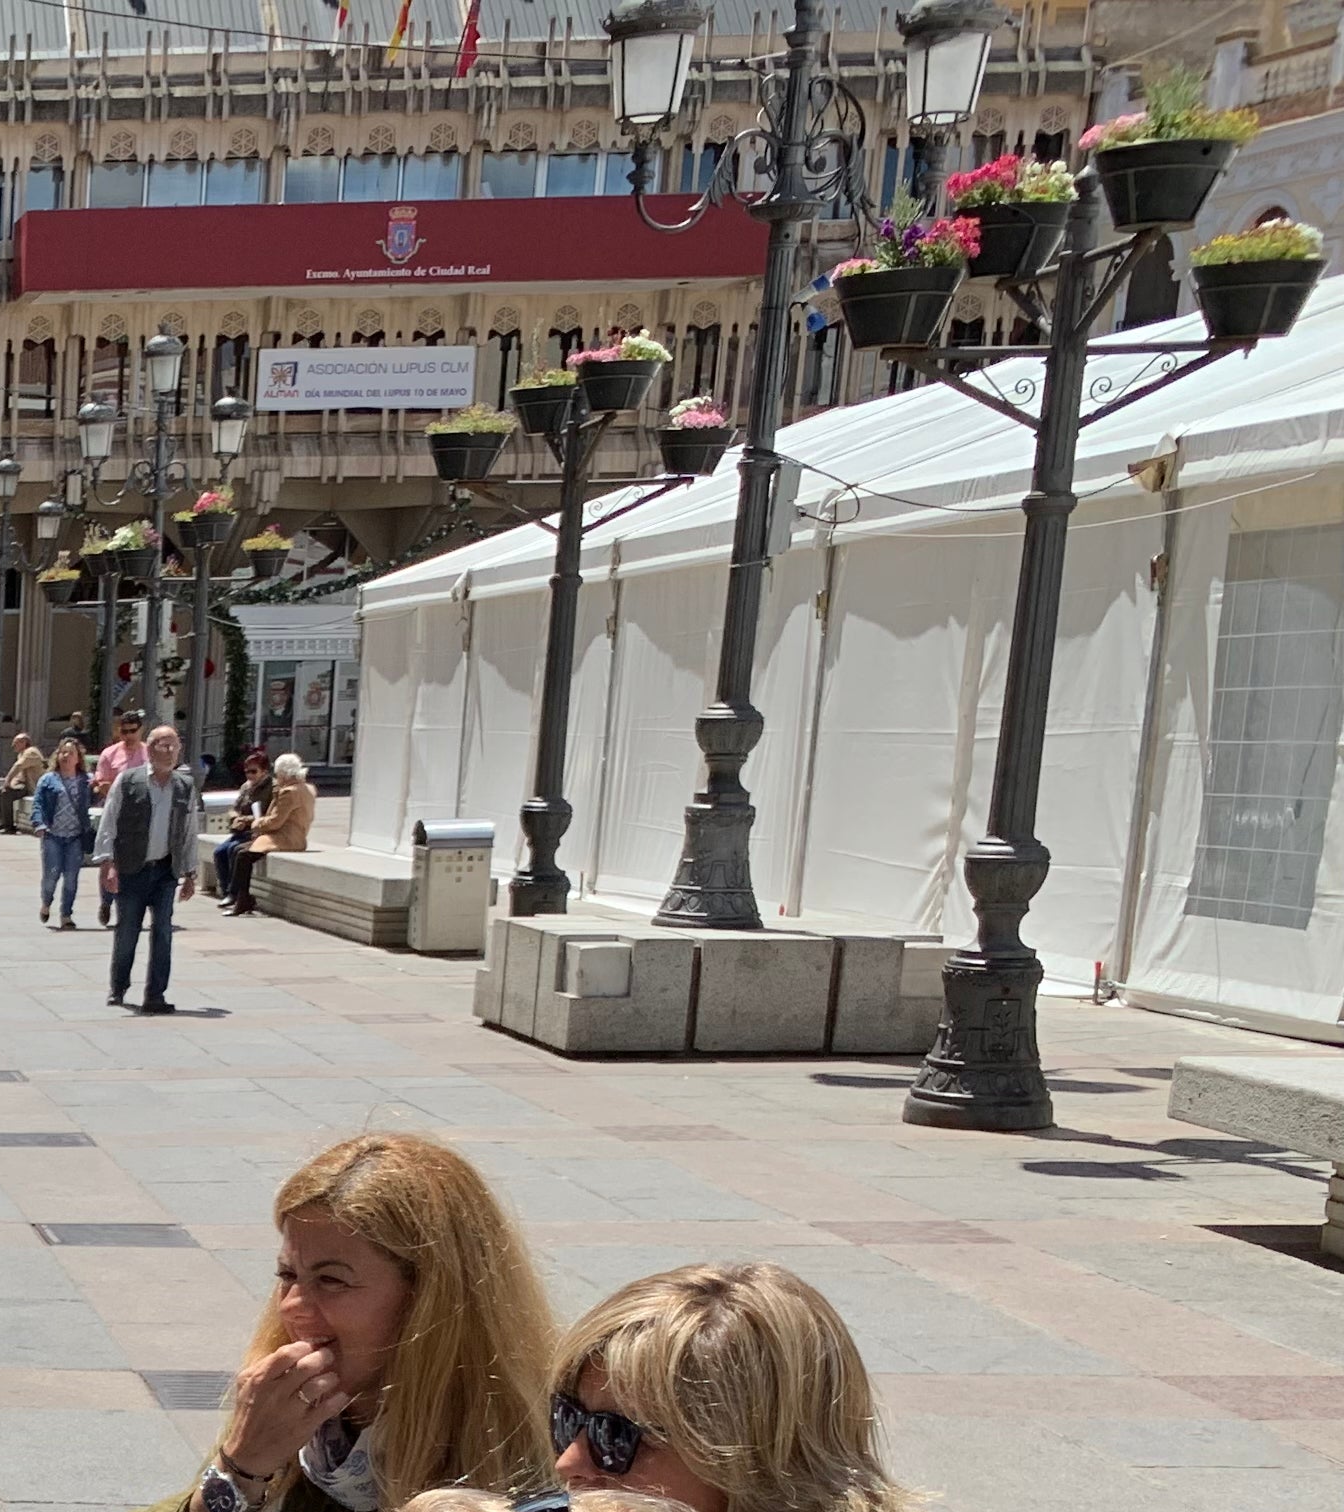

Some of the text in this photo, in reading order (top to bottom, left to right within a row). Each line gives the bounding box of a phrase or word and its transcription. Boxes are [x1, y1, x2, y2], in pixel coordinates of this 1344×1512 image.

[306, 264, 491, 281] Excmo. Ayuntamiento de Ciudad Real
[306, 360, 469, 375] ASOCIACIÓN LUPUS CLM
[323, 389, 363, 398] MUNDIAL
[366, 389, 381, 398] DEL
[384, 388, 411, 397] LUPUS
[426, 388, 438, 397] DE
[440, 388, 468, 397] MAYO
